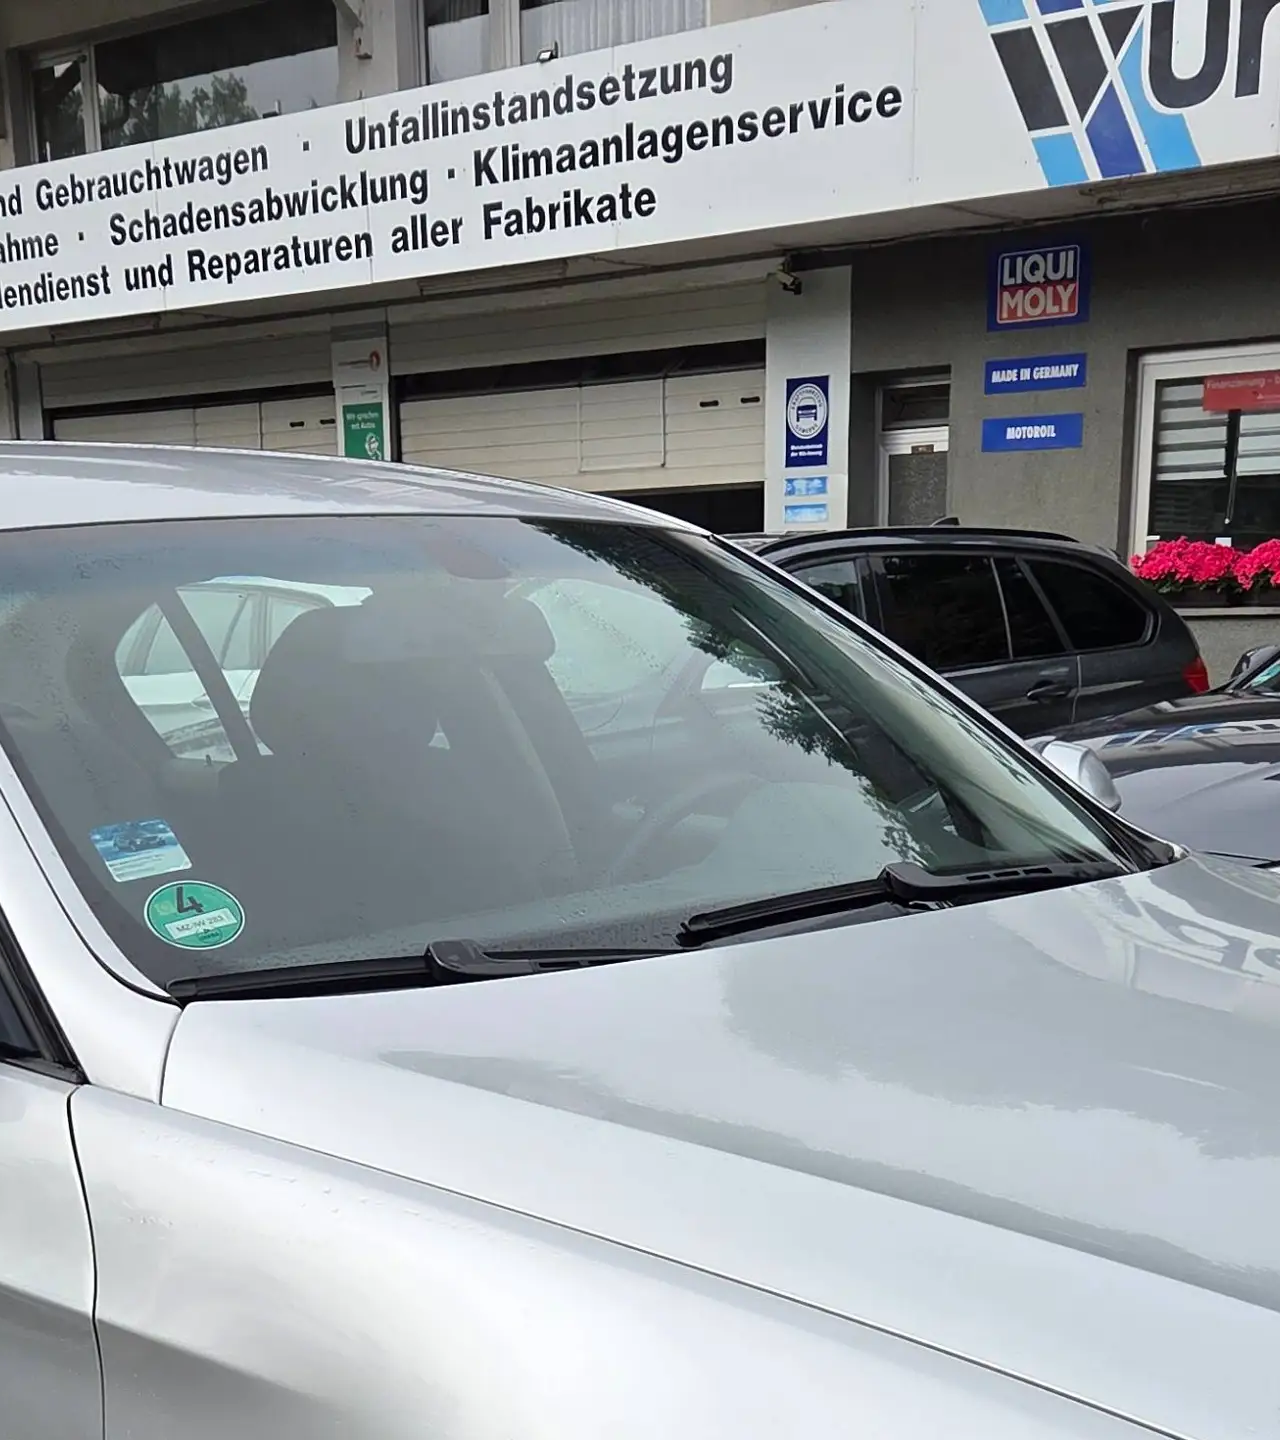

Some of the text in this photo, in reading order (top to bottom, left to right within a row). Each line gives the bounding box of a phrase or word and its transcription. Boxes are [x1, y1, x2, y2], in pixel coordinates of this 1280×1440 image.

[36, 143, 268, 211] Gebrauchtwagen
[344, 52, 734, 155] Unfallinstandsetzung
[110, 168, 428, 246] Schadensabwicklung
[473, 83, 902, 187] Klimaanlagenservice
[125, 253, 174, 292] und
[187, 229, 373, 284] Reparaturen
[391, 212, 464, 254] aller
[482, 183, 657, 240] Fabrikate
[1002, 250, 1075, 285] LIQUI
[1001, 283, 1076, 319] MOLY
[991, 363, 1080, 383] MADE IN GERMANY
[1006, 425, 1056, 440] MOTOROIL
[176, 886, 204, 914] 4
